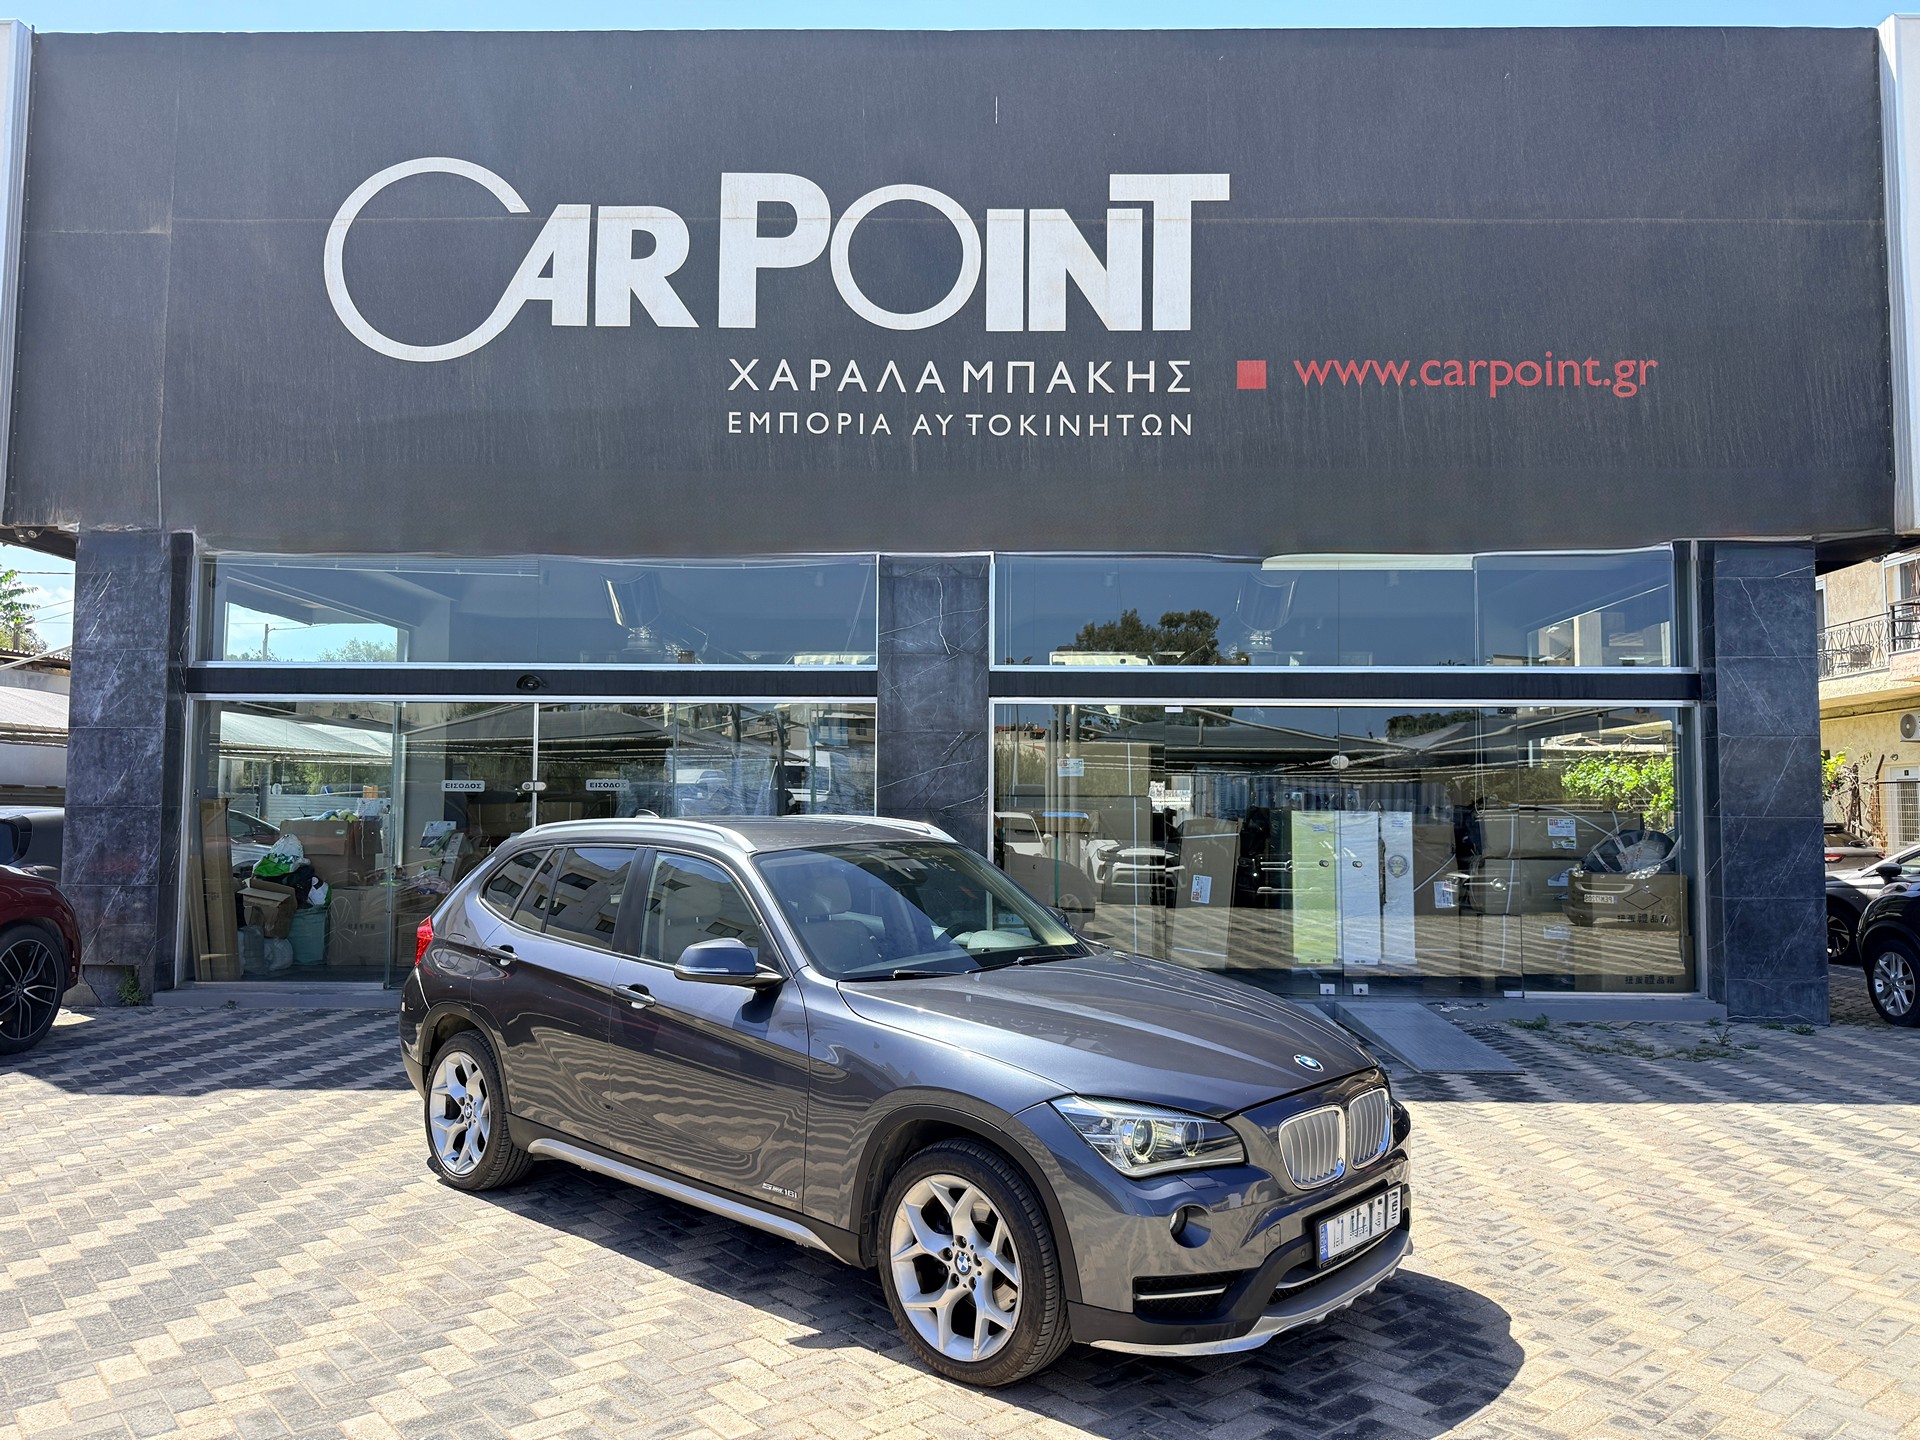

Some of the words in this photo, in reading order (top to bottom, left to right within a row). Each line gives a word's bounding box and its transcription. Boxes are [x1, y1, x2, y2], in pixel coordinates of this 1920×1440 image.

[324, 157, 699, 362] CAR
[718, 172, 1231, 332] POINT
[1294, 351, 1658, 398] www.carpoint.gr
[728, 411, 892, 435] ΕΜΠΟΡΙΑ
